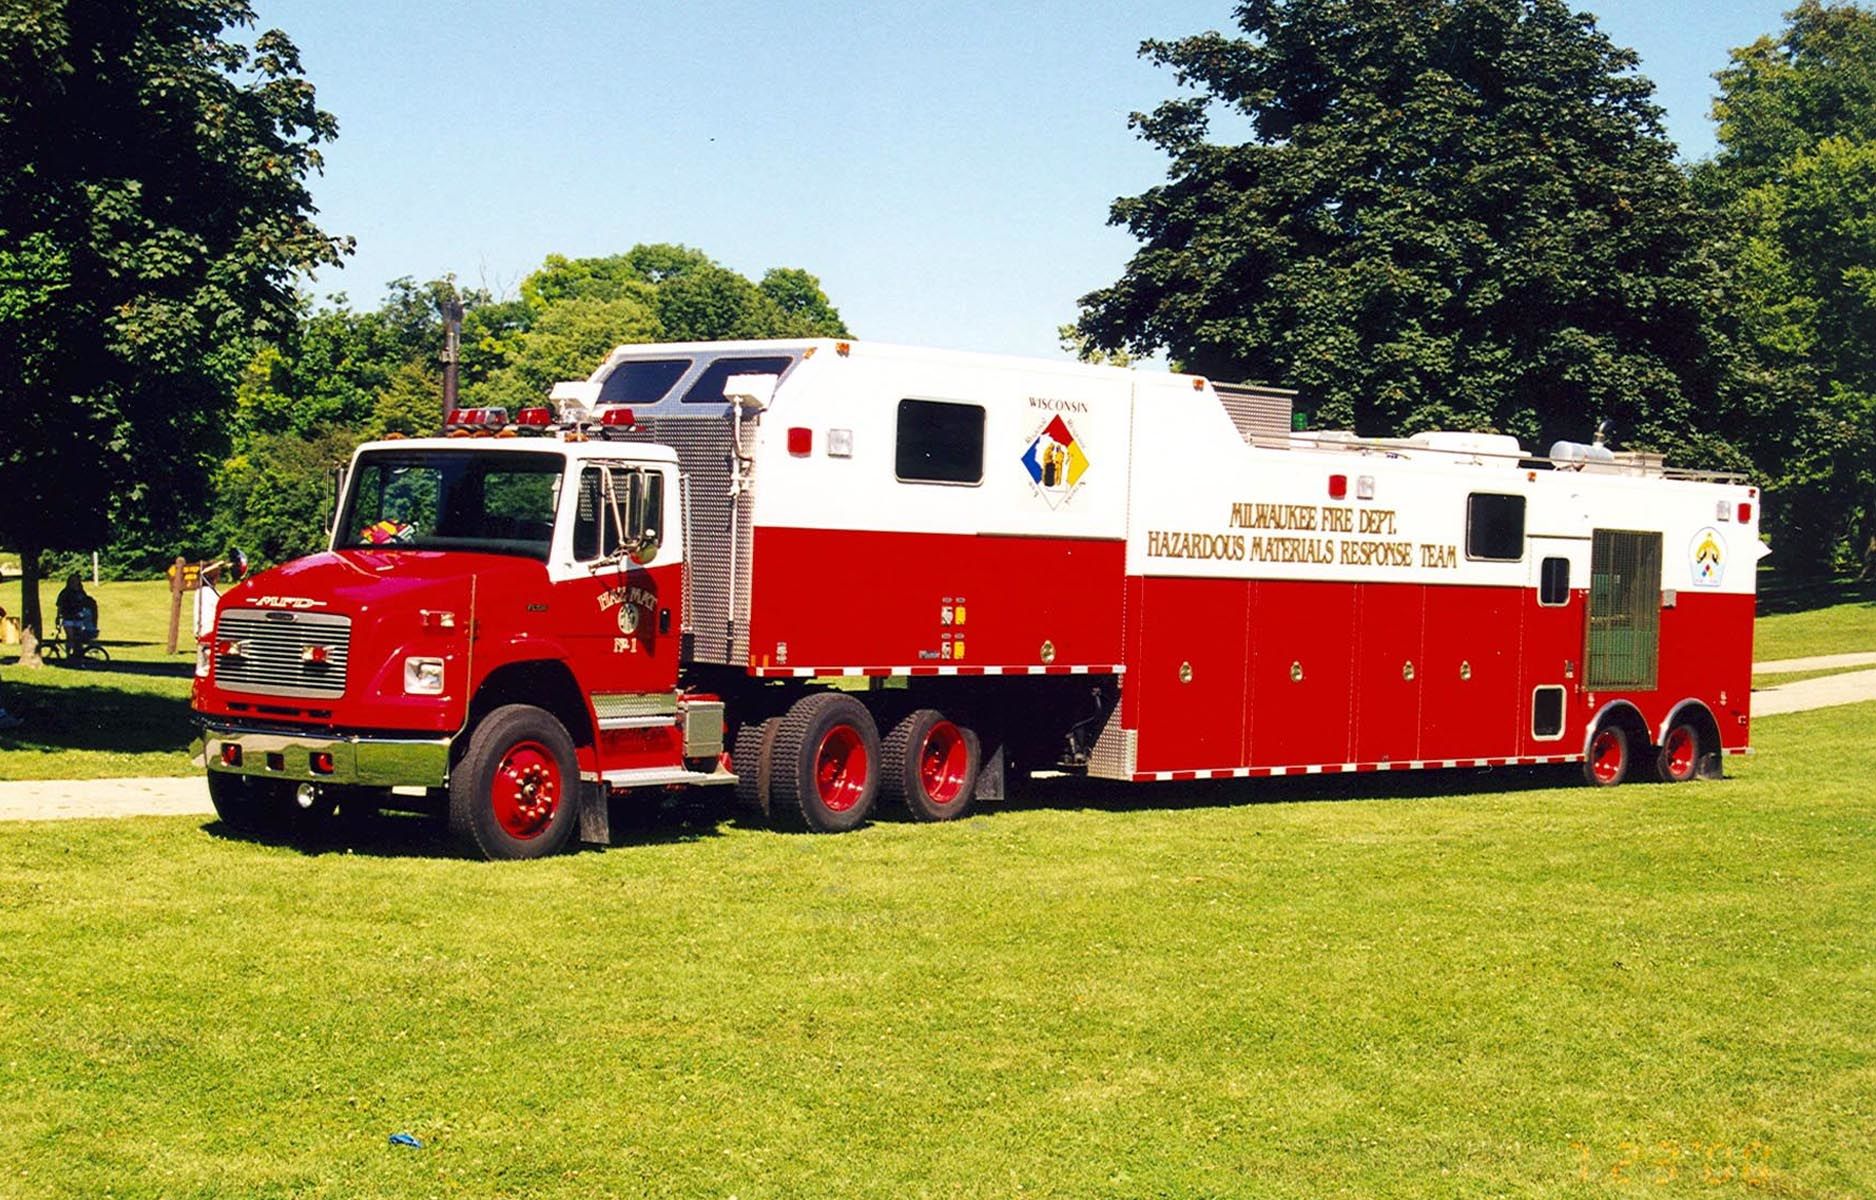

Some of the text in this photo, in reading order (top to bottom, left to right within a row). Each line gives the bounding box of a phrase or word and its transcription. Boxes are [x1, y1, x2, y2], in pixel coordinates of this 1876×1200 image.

[1028, 396, 1088, 413] WISCONSIN
[1229, 502, 1397, 535] MILWAUKEE FIRE DEPT.
[1147, 531, 1457, 568] HAZARDOUS MATERIALS RESPONSE TEAM
[597, 586, 658, 611] HAZ MAT
